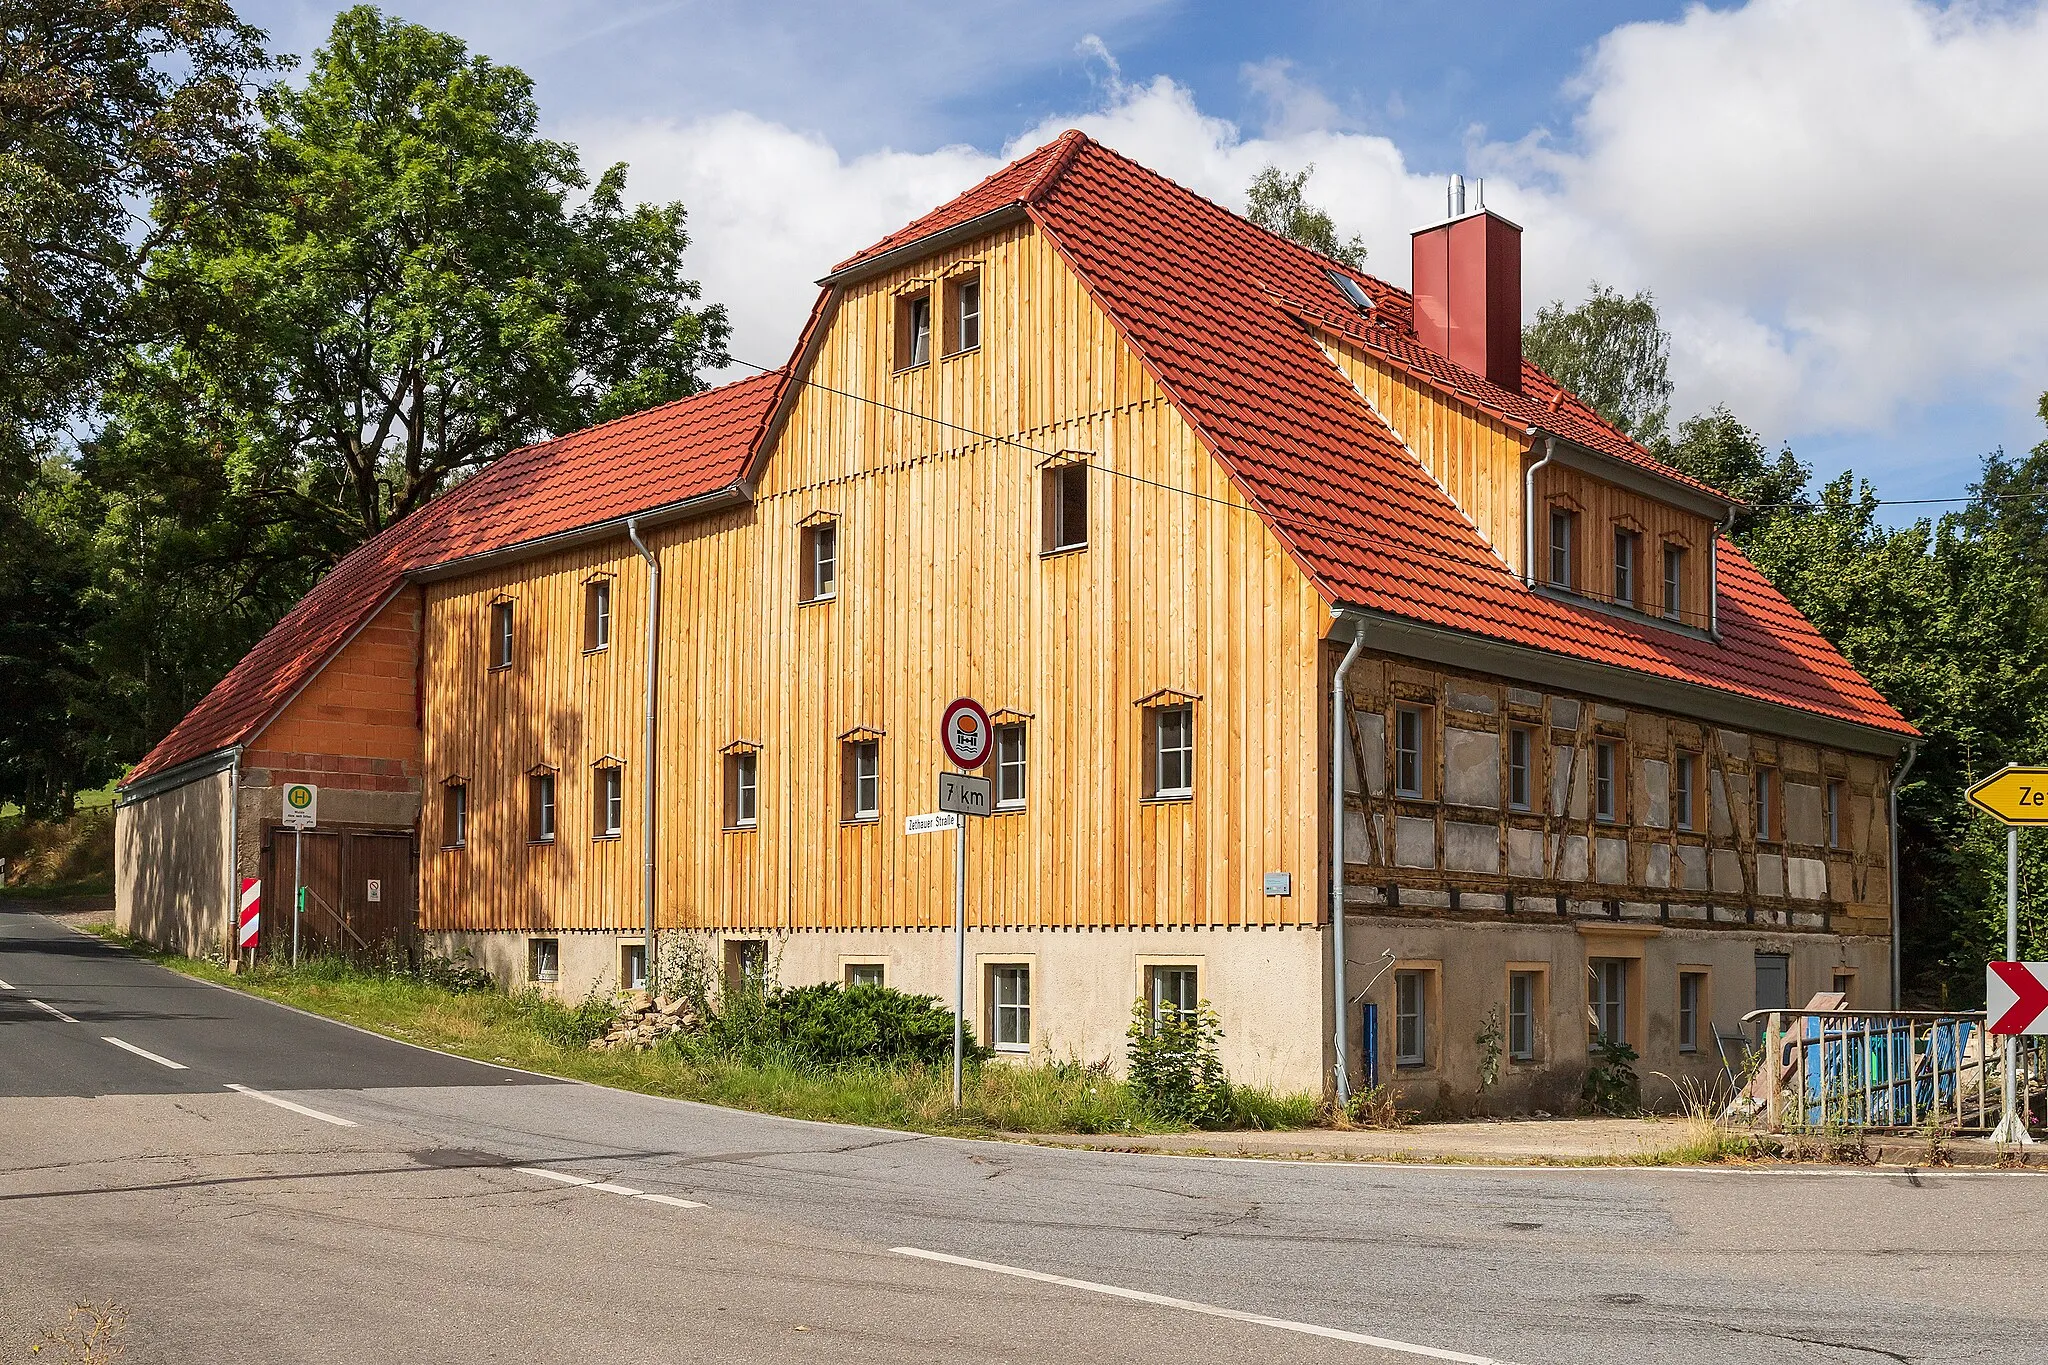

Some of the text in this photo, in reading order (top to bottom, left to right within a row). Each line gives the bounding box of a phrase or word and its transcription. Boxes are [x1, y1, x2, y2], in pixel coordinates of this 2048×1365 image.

[946, 783, 984, 807] 7 km
[2018, 786, 2048, 807] Ze
[935, 814, 955, 827] Straße
